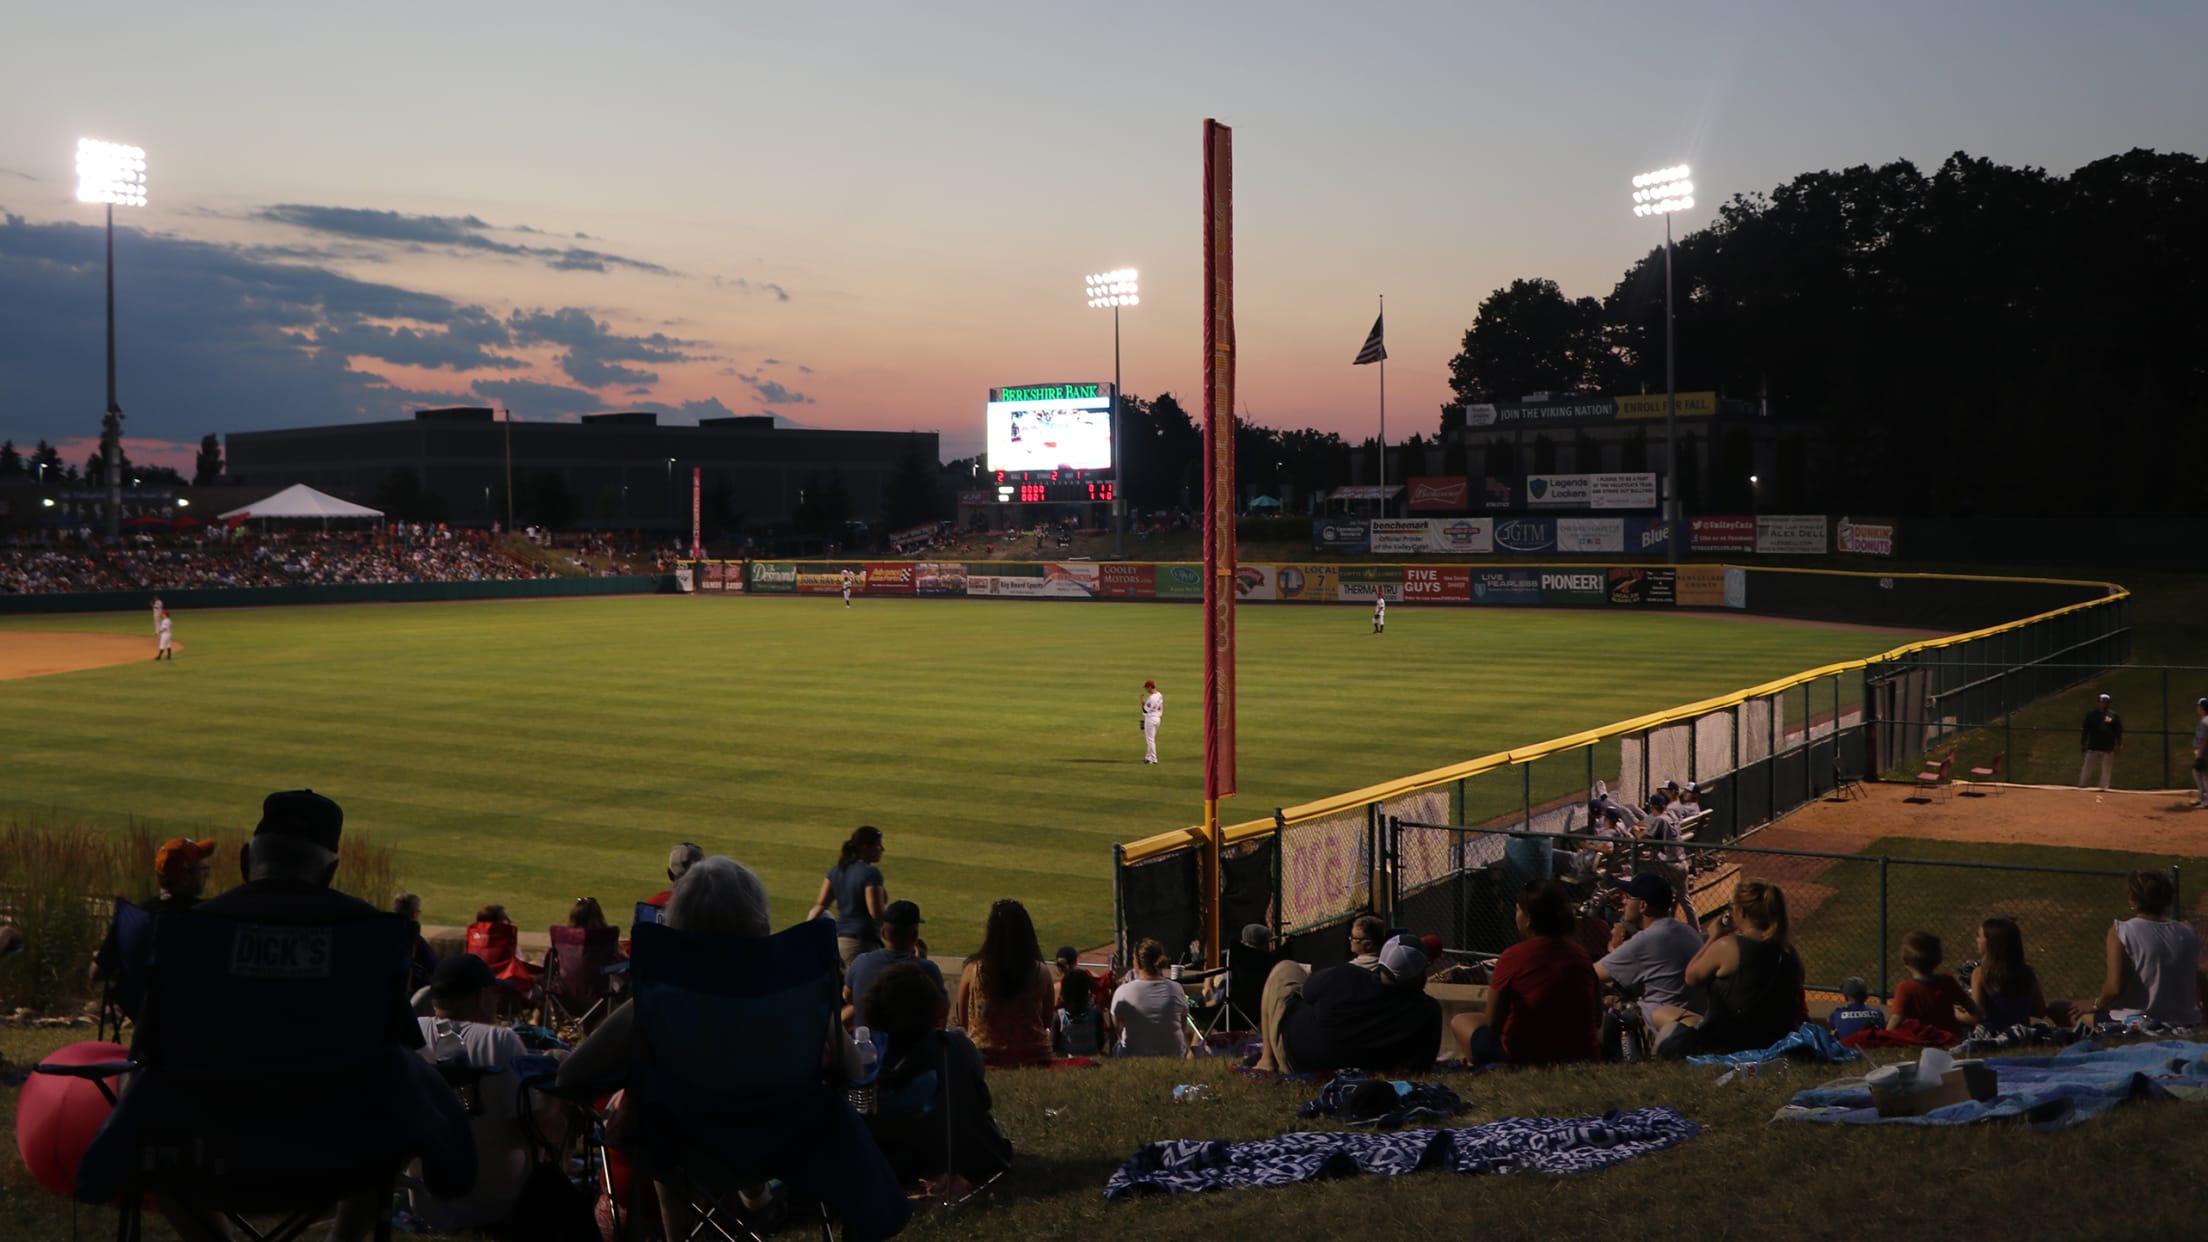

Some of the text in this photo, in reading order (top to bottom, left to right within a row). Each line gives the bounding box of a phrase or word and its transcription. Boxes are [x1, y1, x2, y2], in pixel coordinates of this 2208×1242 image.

[1002, 384, 1098, 401] BERKSHIRE BANK
[1664, 400, 1682, 411] FR
[1501, 409, 1520, 421] JOIN
[1522, 408, 1539, 418] THE
[1540, 406, 1573, 418] VIKING
[1574, 404, 1613, 416] NATION!
[1550, 479, 1588, 488] Legends
[1373, 520, 1428, 529] benchemark
[1642, 527, 1669, 548] Blue
[1318, 575, 1325, 586] 7
[1408, 570, 1438, 580] FIVE
[1404, 582, 1441, 592] GUYS
[1542, 574, 1598, 590] PIONEER
[236, 935, 326, 967] DICK'S
